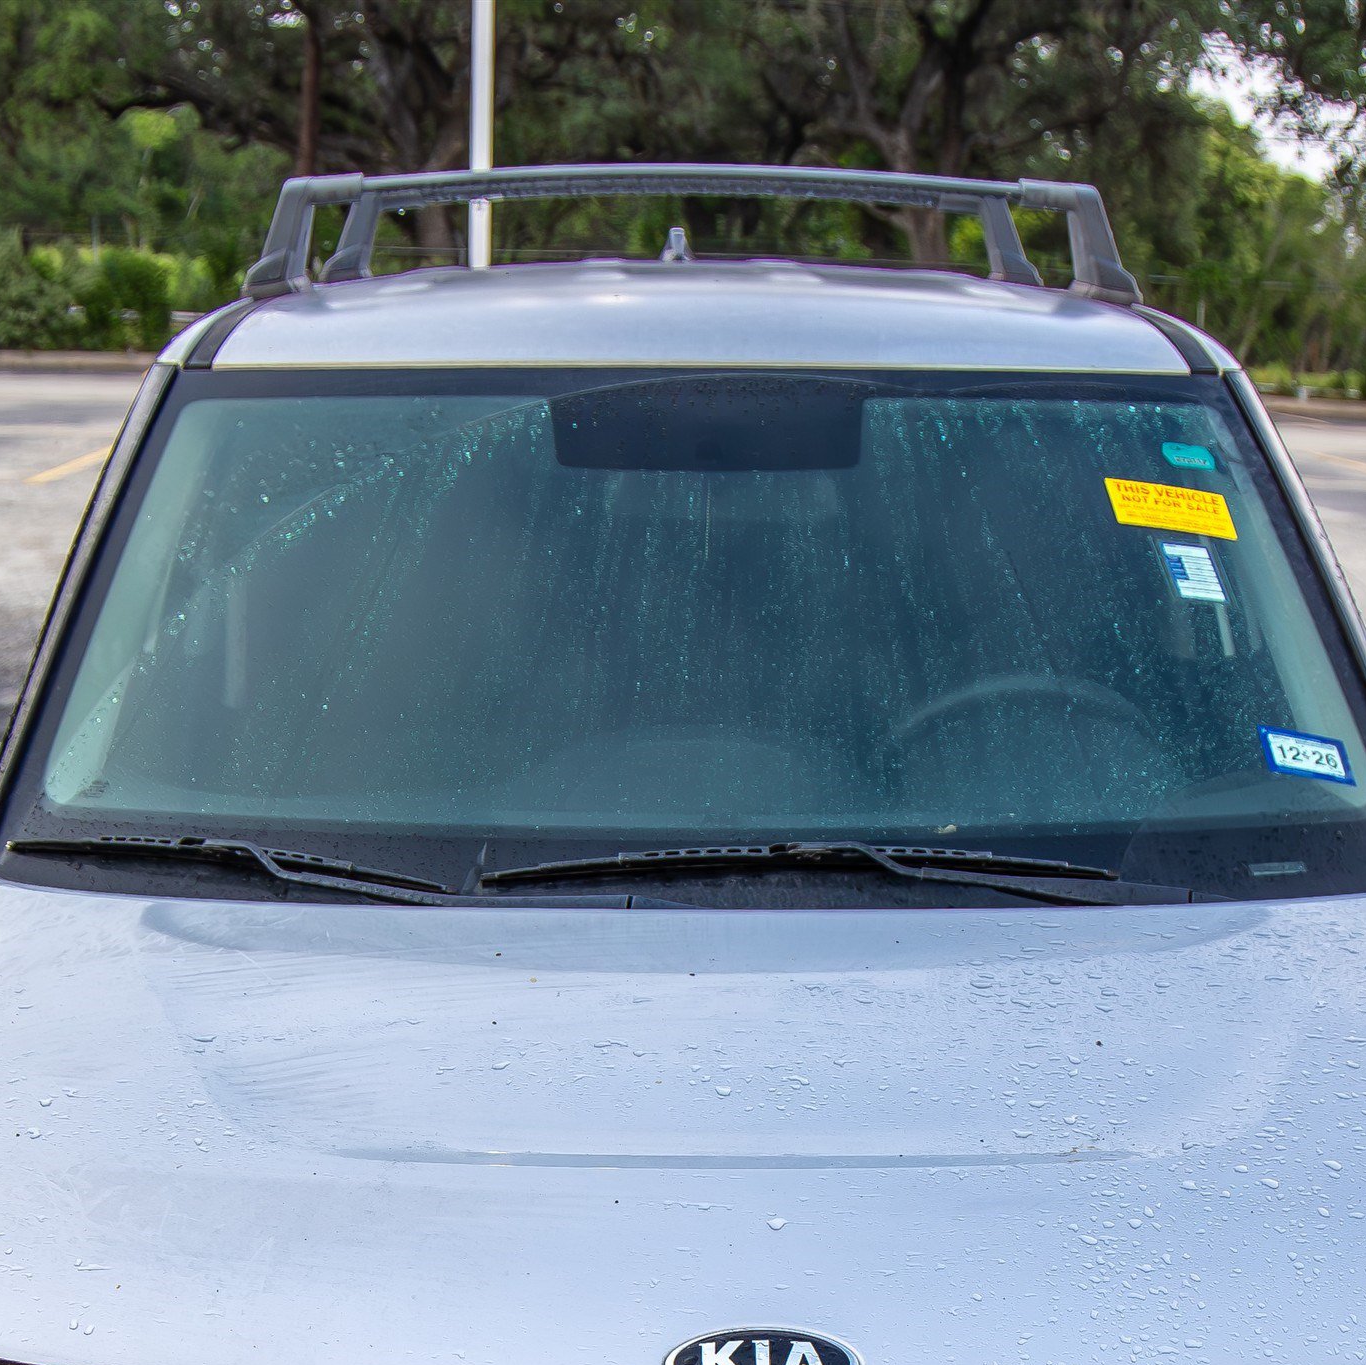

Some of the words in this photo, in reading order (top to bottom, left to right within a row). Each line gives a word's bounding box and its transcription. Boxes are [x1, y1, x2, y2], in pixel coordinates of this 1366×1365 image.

[1114, 481, 1150, 495] THIS
[1154, 487, 1221, 506] VEHICLE
[1121, 494, 1148, 504] NOT
[1153, 498, 1182, 508] FOR
[1187, 503, 1220, 515] SALE
